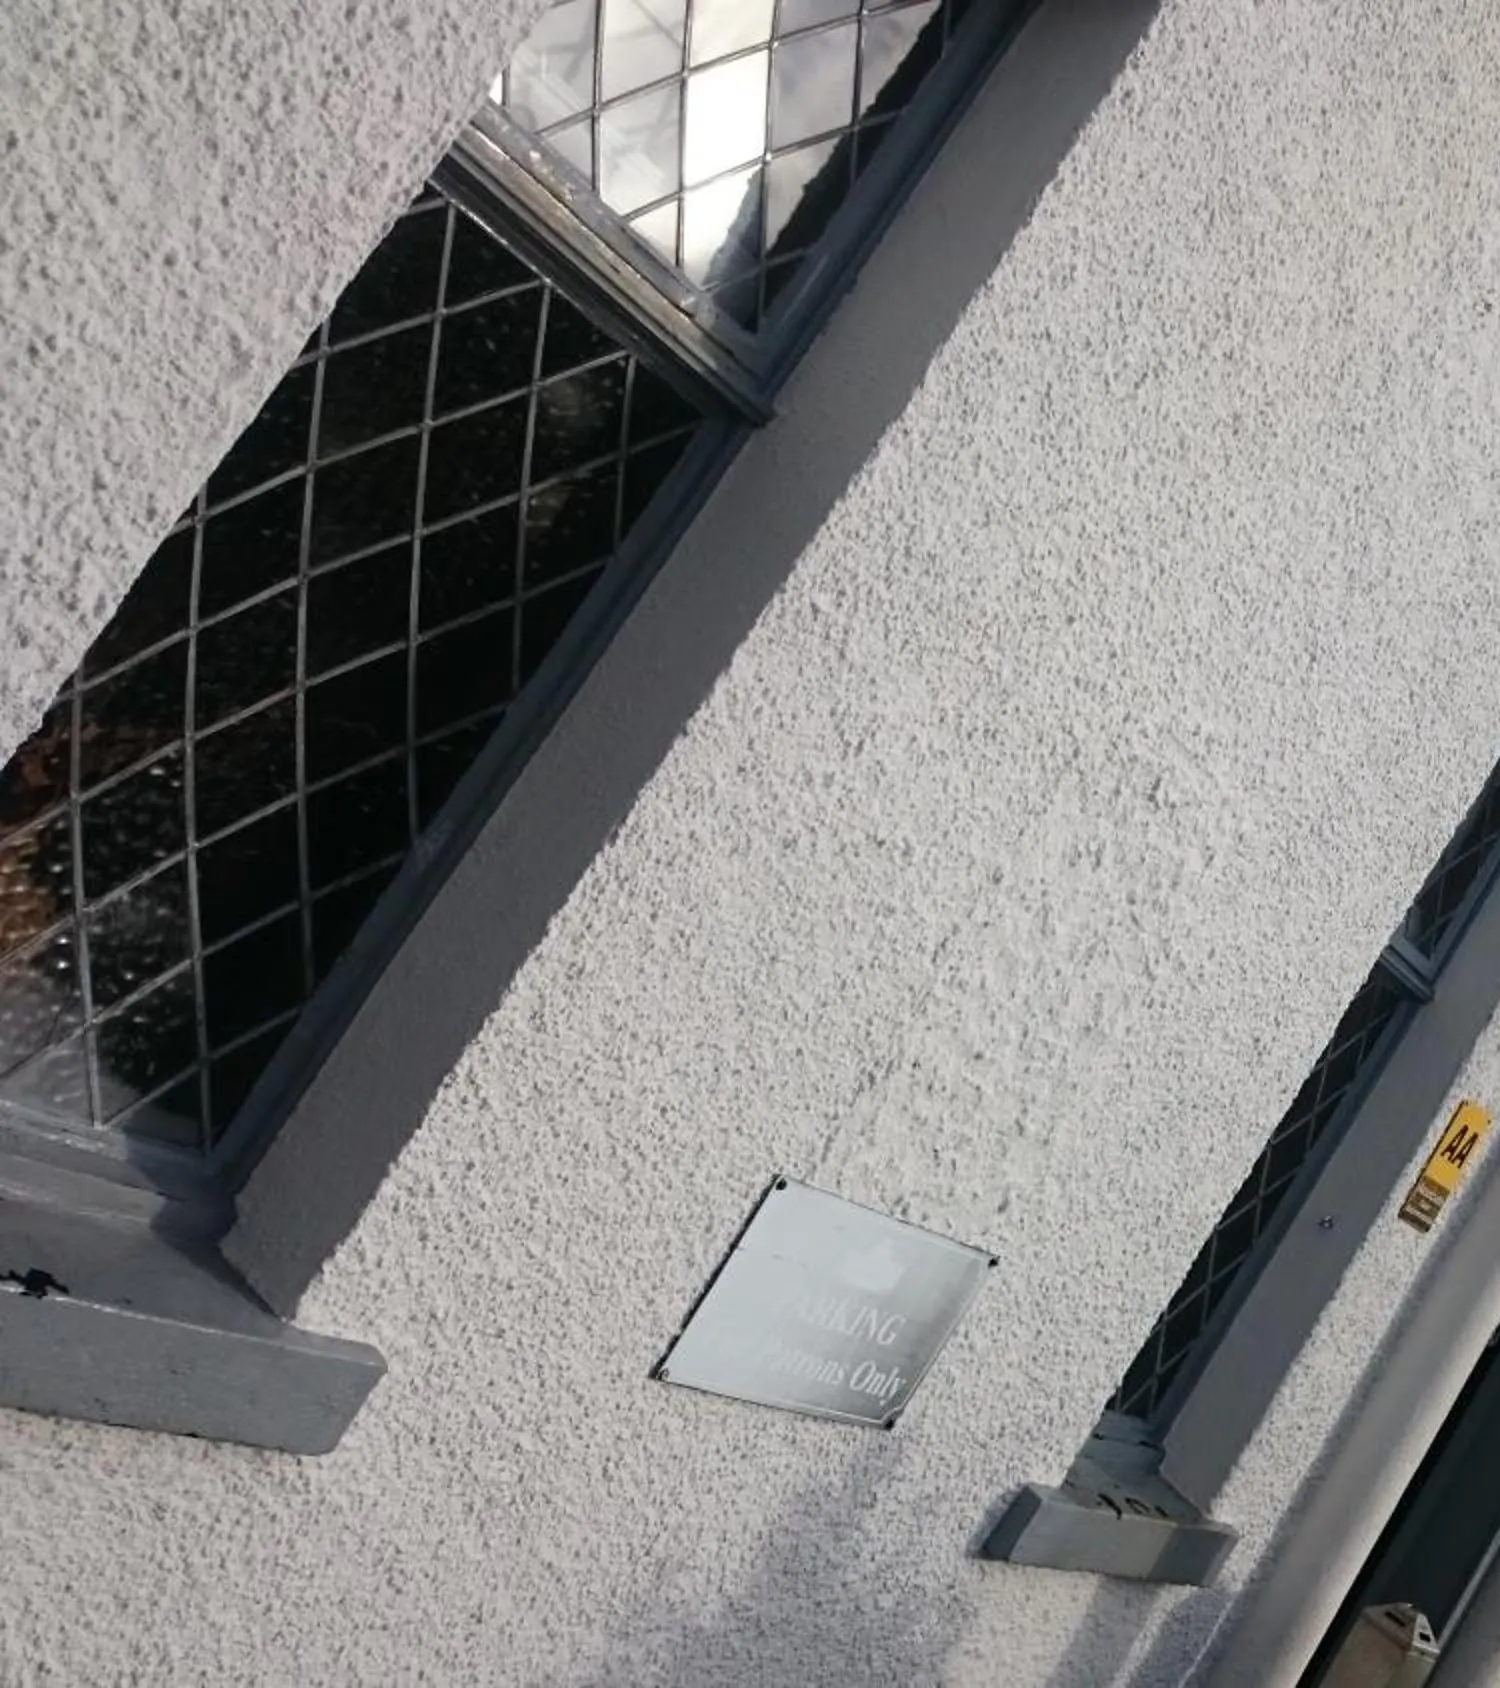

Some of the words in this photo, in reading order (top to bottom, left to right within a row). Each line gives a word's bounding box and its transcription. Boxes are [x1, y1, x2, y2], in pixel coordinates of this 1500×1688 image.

[1440, 1124, 1479, 1168] AA
[778, 1293, 906, 1346] ARKING
[852, 1359, 907, 1407] Only
